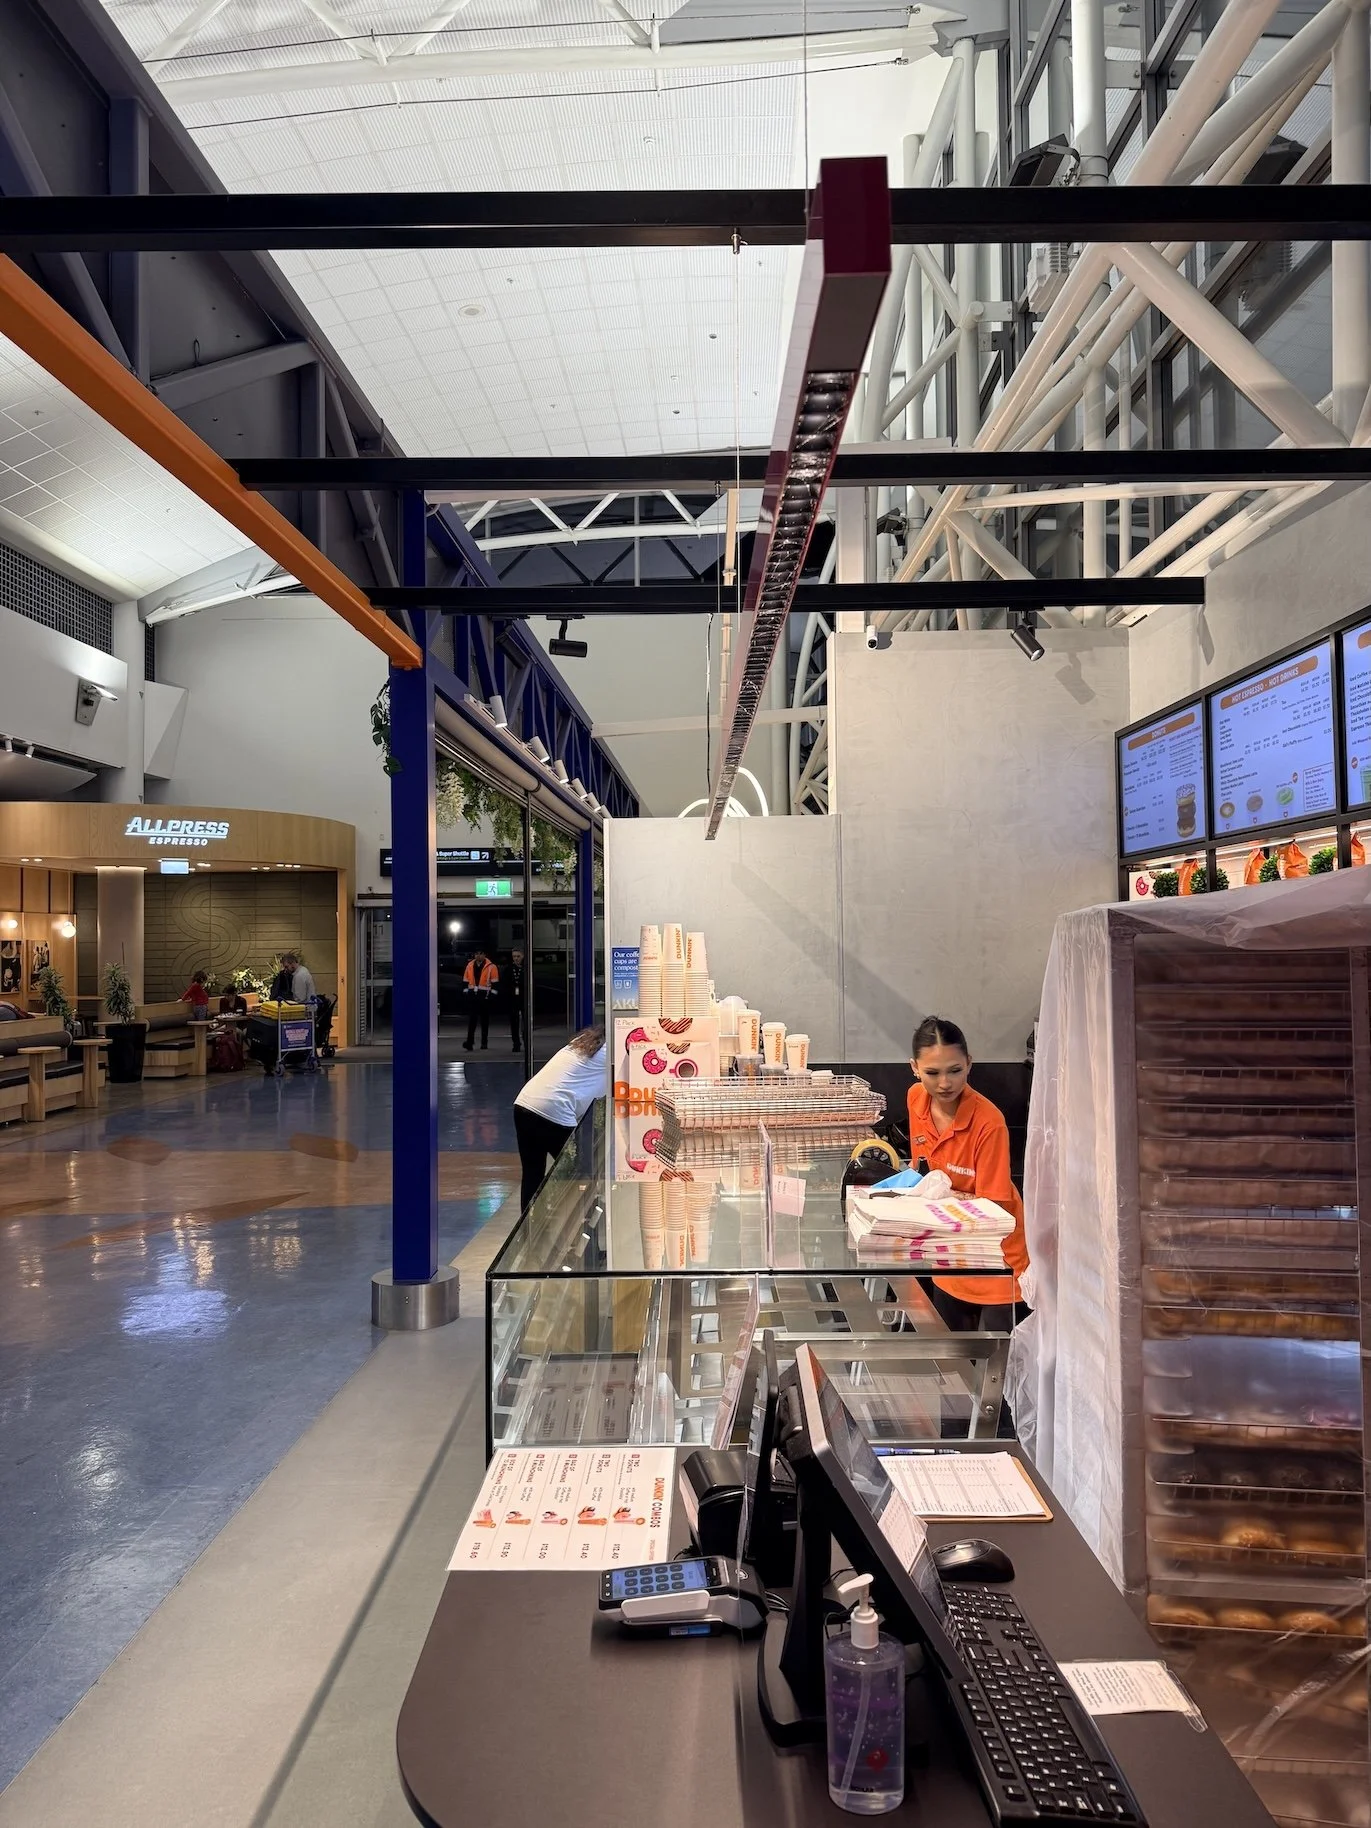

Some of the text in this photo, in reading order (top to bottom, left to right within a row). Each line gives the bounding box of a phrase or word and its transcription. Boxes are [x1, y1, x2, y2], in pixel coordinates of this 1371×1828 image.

[1231, 694, 1241, 703] HOT
[1242, 683, 1264, 699] ESPRESSO
[1269, 677, 1279, 687] HOT
[1280, 667, 1299, 682] DRINKS
[149, 837, 208, 846] ESPRESSO
[649, 1502, 662, 1528] COMBOS
